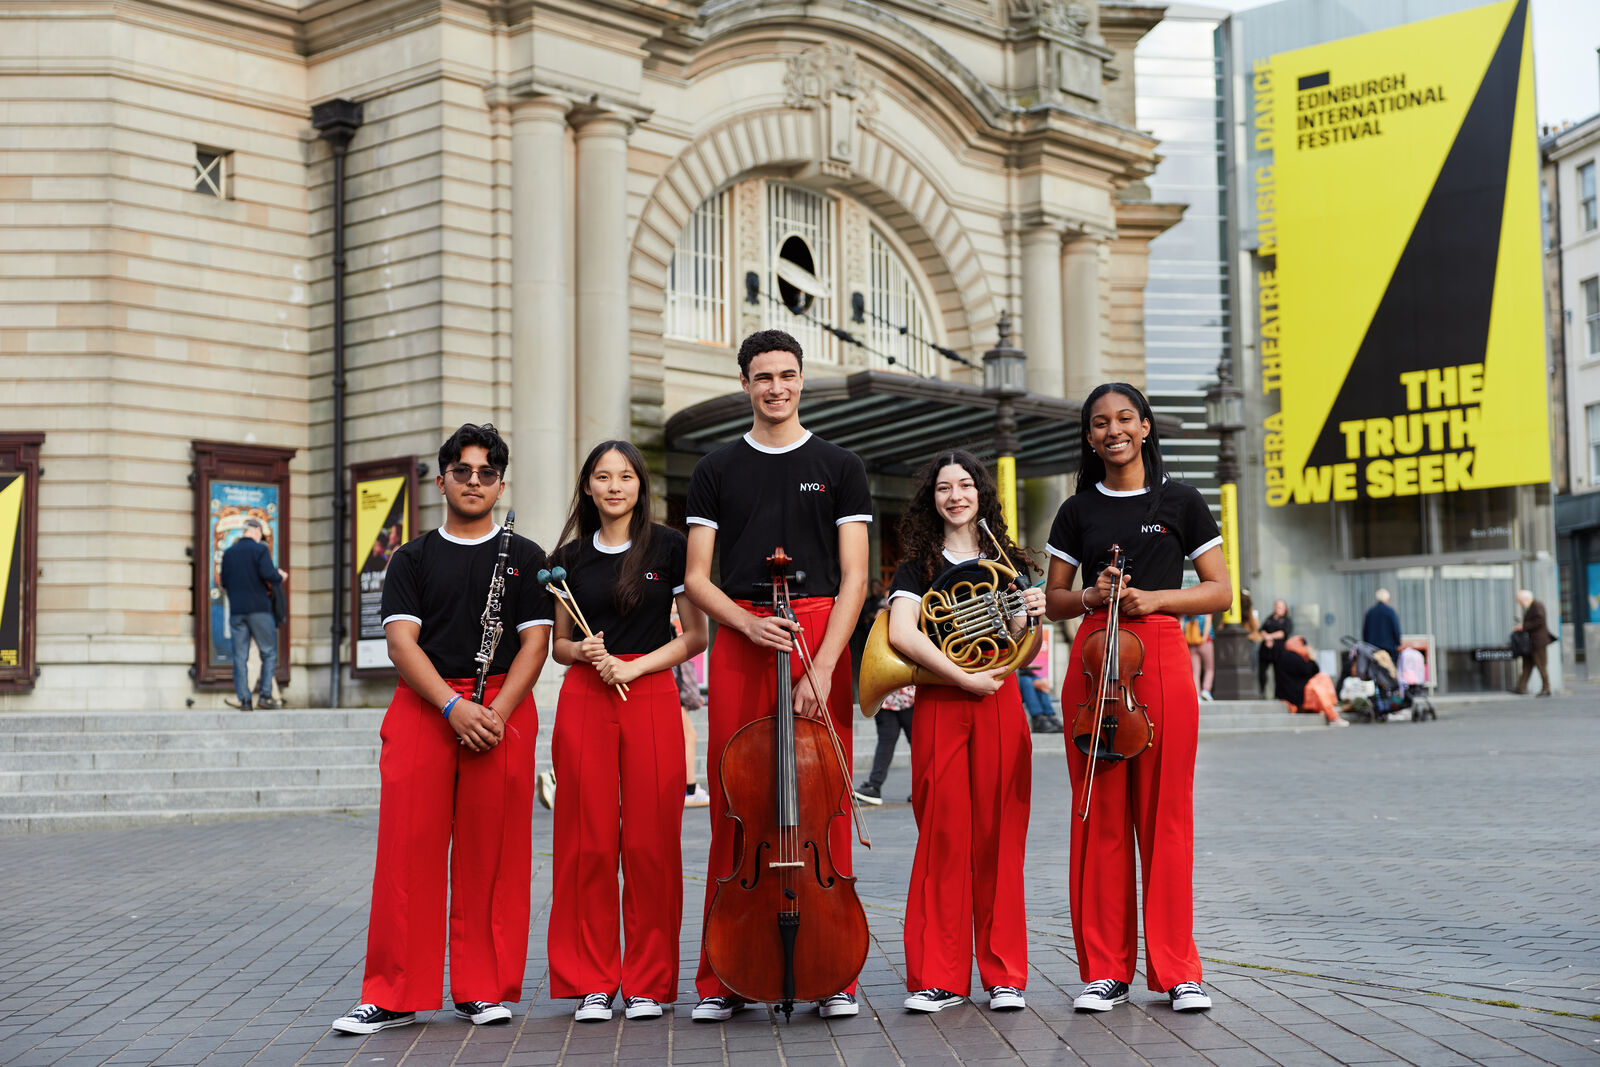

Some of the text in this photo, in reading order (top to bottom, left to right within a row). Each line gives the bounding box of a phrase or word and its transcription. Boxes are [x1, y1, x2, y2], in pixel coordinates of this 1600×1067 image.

[1297, 73, 1406, 111] EDINBURGH
[1297, 86, 1447, 130] INTERNATIONAL
[1297, 120, 1383, 150] FESTIVAL
[1253, 57, 1287, 507] OPERA THEATRE MUSIC DANCE
[1400, 363, 1484, 411] THE
[1340, 407, 1480, 459] TRUTH
[800, 483, 826, 492] NYO2
[1291, 451, 1476, 504] WE SEEK
[1141, 524, 1168, 533] NYO2
